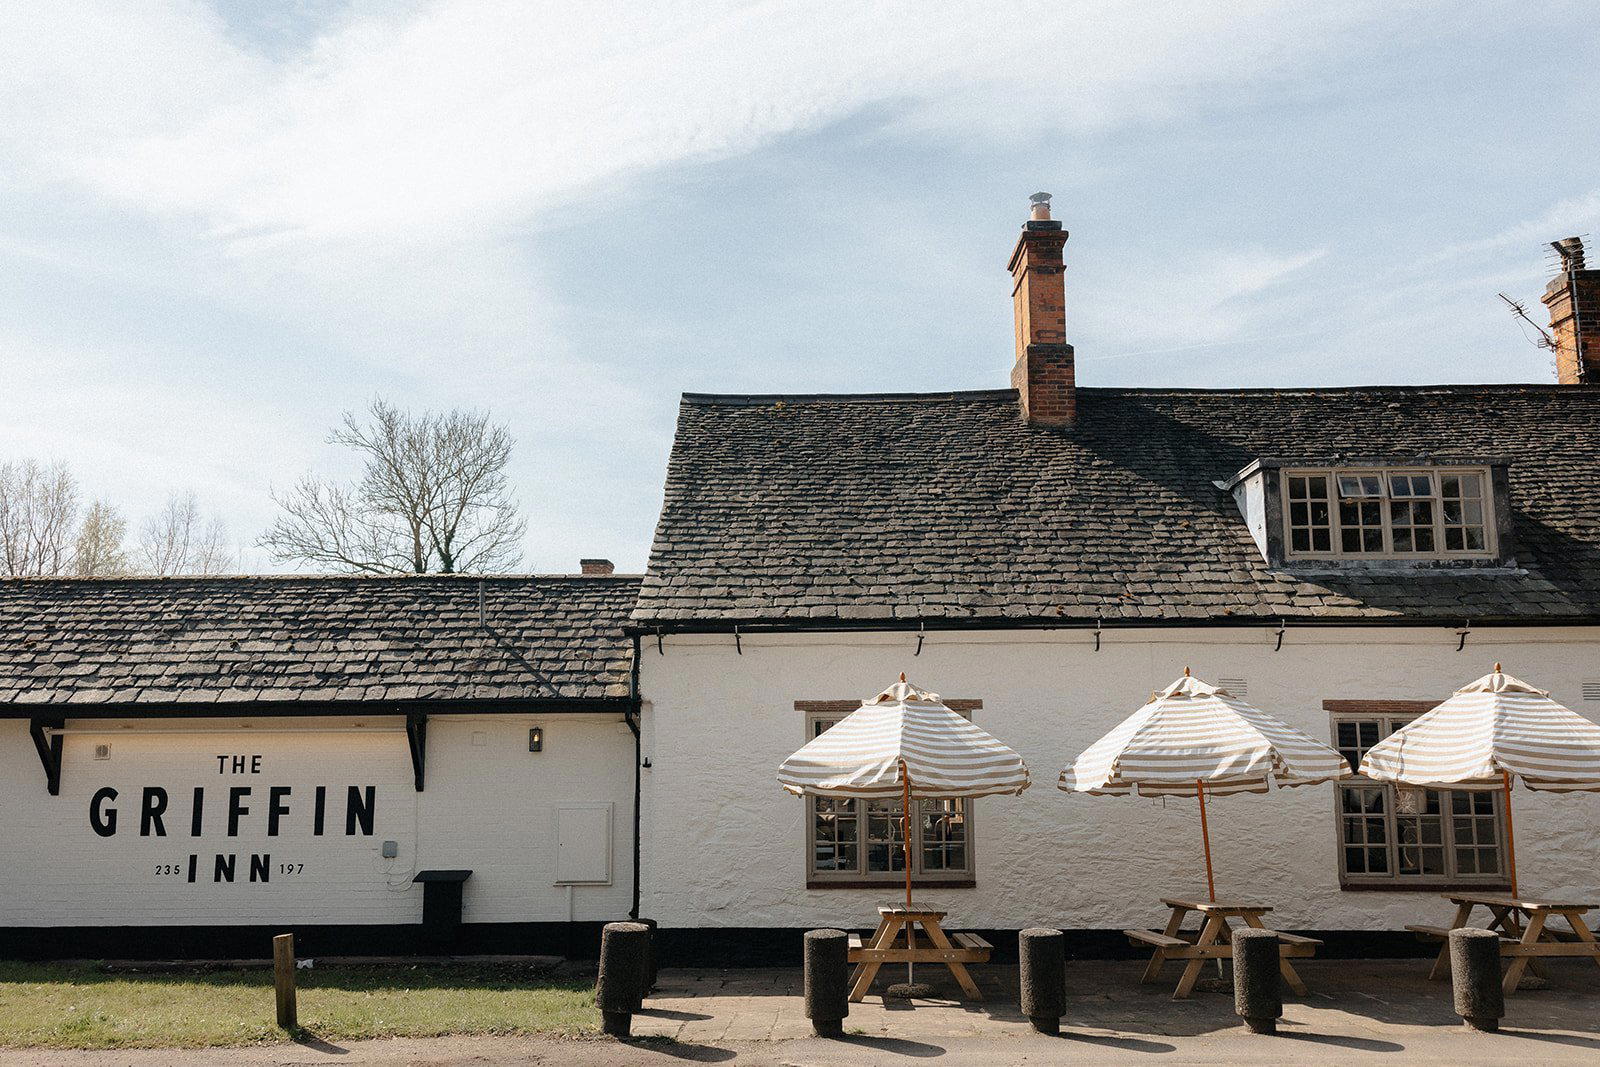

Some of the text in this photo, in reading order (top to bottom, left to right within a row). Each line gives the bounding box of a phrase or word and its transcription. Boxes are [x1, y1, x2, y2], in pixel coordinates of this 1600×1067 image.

[217, 755, 262, 774] THE
[89, 786, 376, 837] GRIFFIN
[155, 854, 304, 883] 235 INN 197
